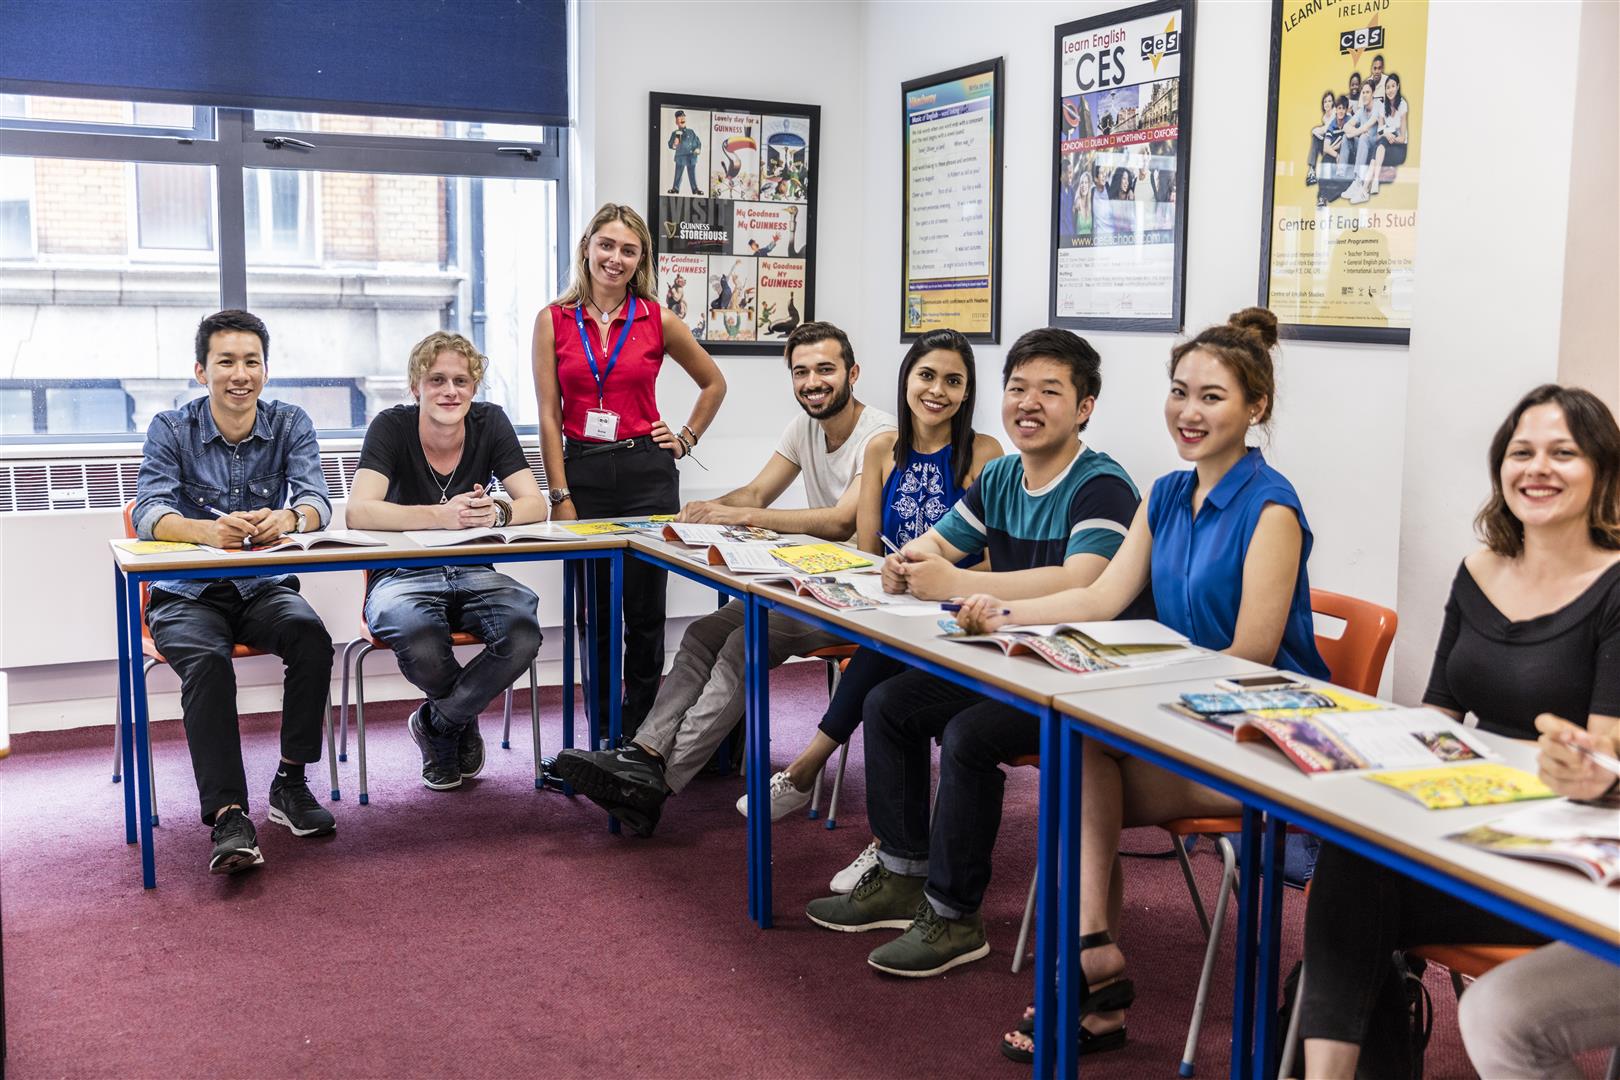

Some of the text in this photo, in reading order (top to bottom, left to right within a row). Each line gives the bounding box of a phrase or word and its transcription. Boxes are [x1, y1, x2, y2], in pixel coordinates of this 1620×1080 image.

[1338, 0, 1390, 18] IRELAND
[1284, 0, 1322, 32] LEARN
[1064, 28, 1126, 54] Learn English
[1076, 46, 1126, 91] CES
[714, 114, 732, 122] Lovely
[734, 116, 744, 125] day
[714, 124, 743, 133] GUINNESS
[1061, 140, 1084, 152] LONDON
[1090, 136, 1108, 148] DUBLIN
[1116, 131, 1146, 144] WORTHING
[669, 196, 728, 227] VISIT
[736, 208, 780, 218] My Goodness
[680, 222, 710, 230] GUINNESS
[738, 219, 788, 230] My GUINNESS
[1278, 218, 1316, 232] Centre
[1337, 214, 1381, 232] Engsh
[680, 230, 728, 241] STOREHOUSE
[660, 256, 669, 264] My
[661, 265, 706, 275] My GUINNESS
[762, 262, 802, 270] My Goodness
[761, 276, 803, 288] GUINNESS
